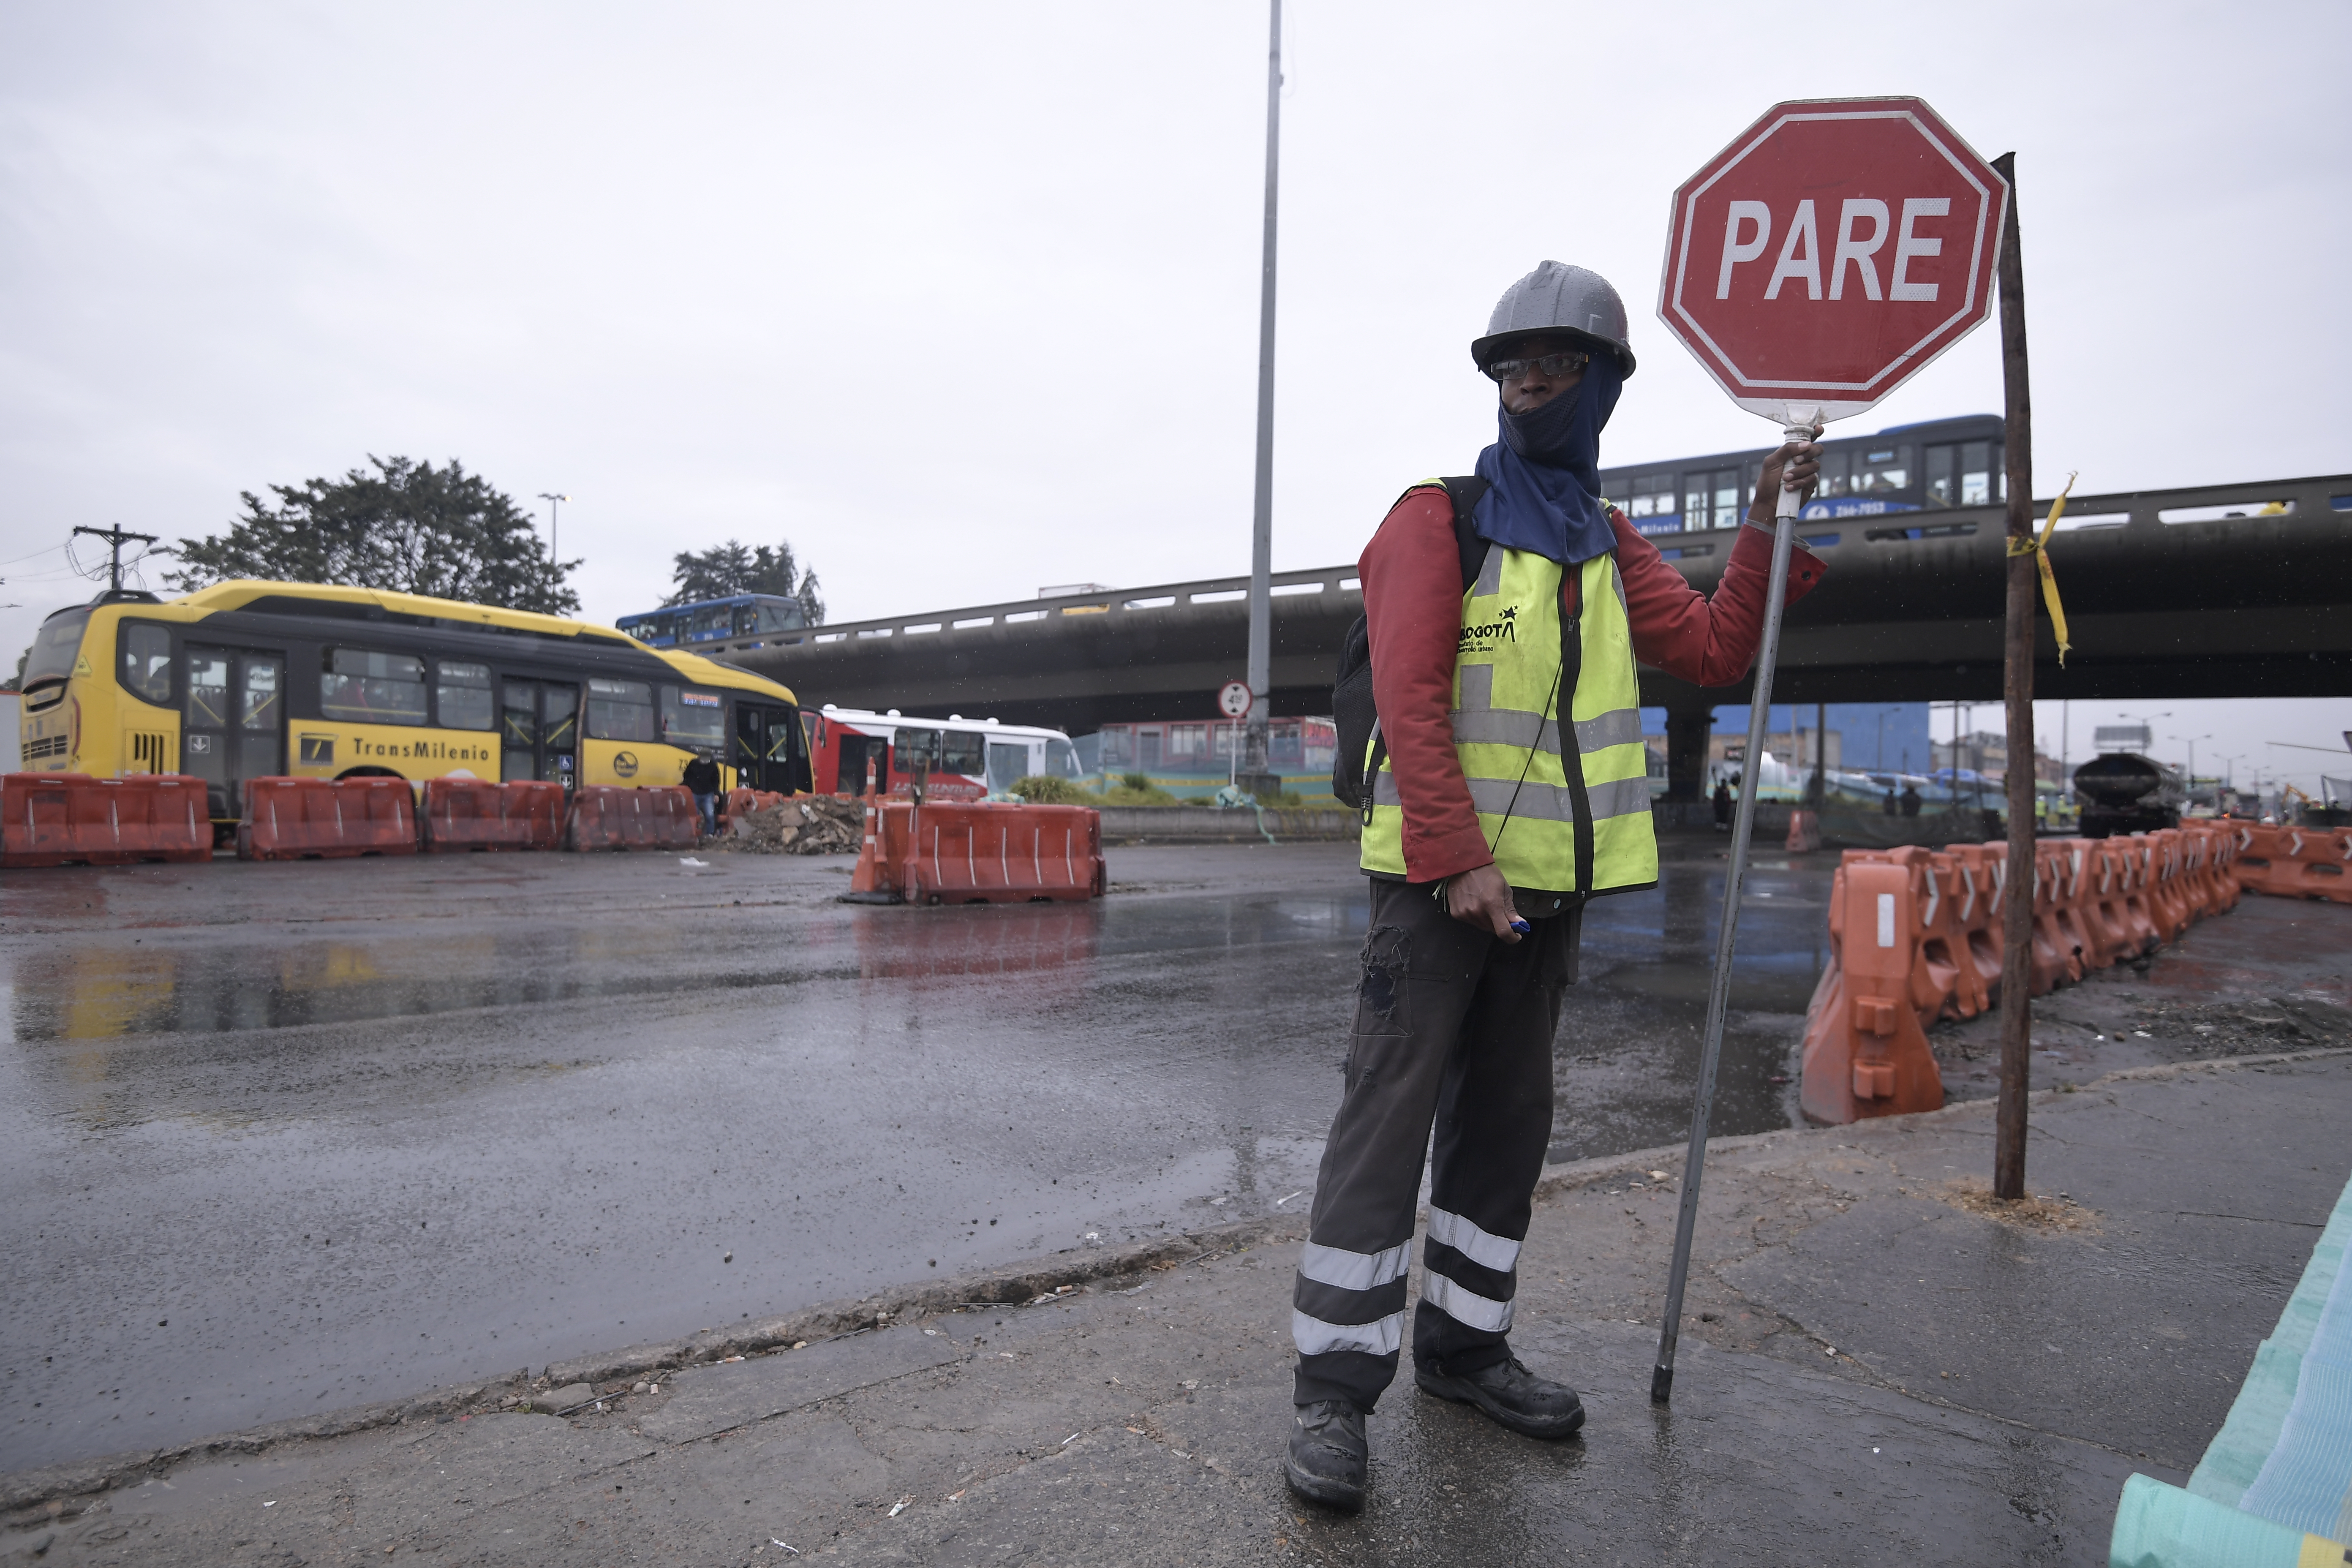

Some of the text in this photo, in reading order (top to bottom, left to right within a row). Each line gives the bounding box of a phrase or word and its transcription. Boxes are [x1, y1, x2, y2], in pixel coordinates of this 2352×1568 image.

[1716, 198, 1951, 302] PARE
[1637, 524, 1679, 534] Milenio
[354, 738, 489, 760] TransMilenio
